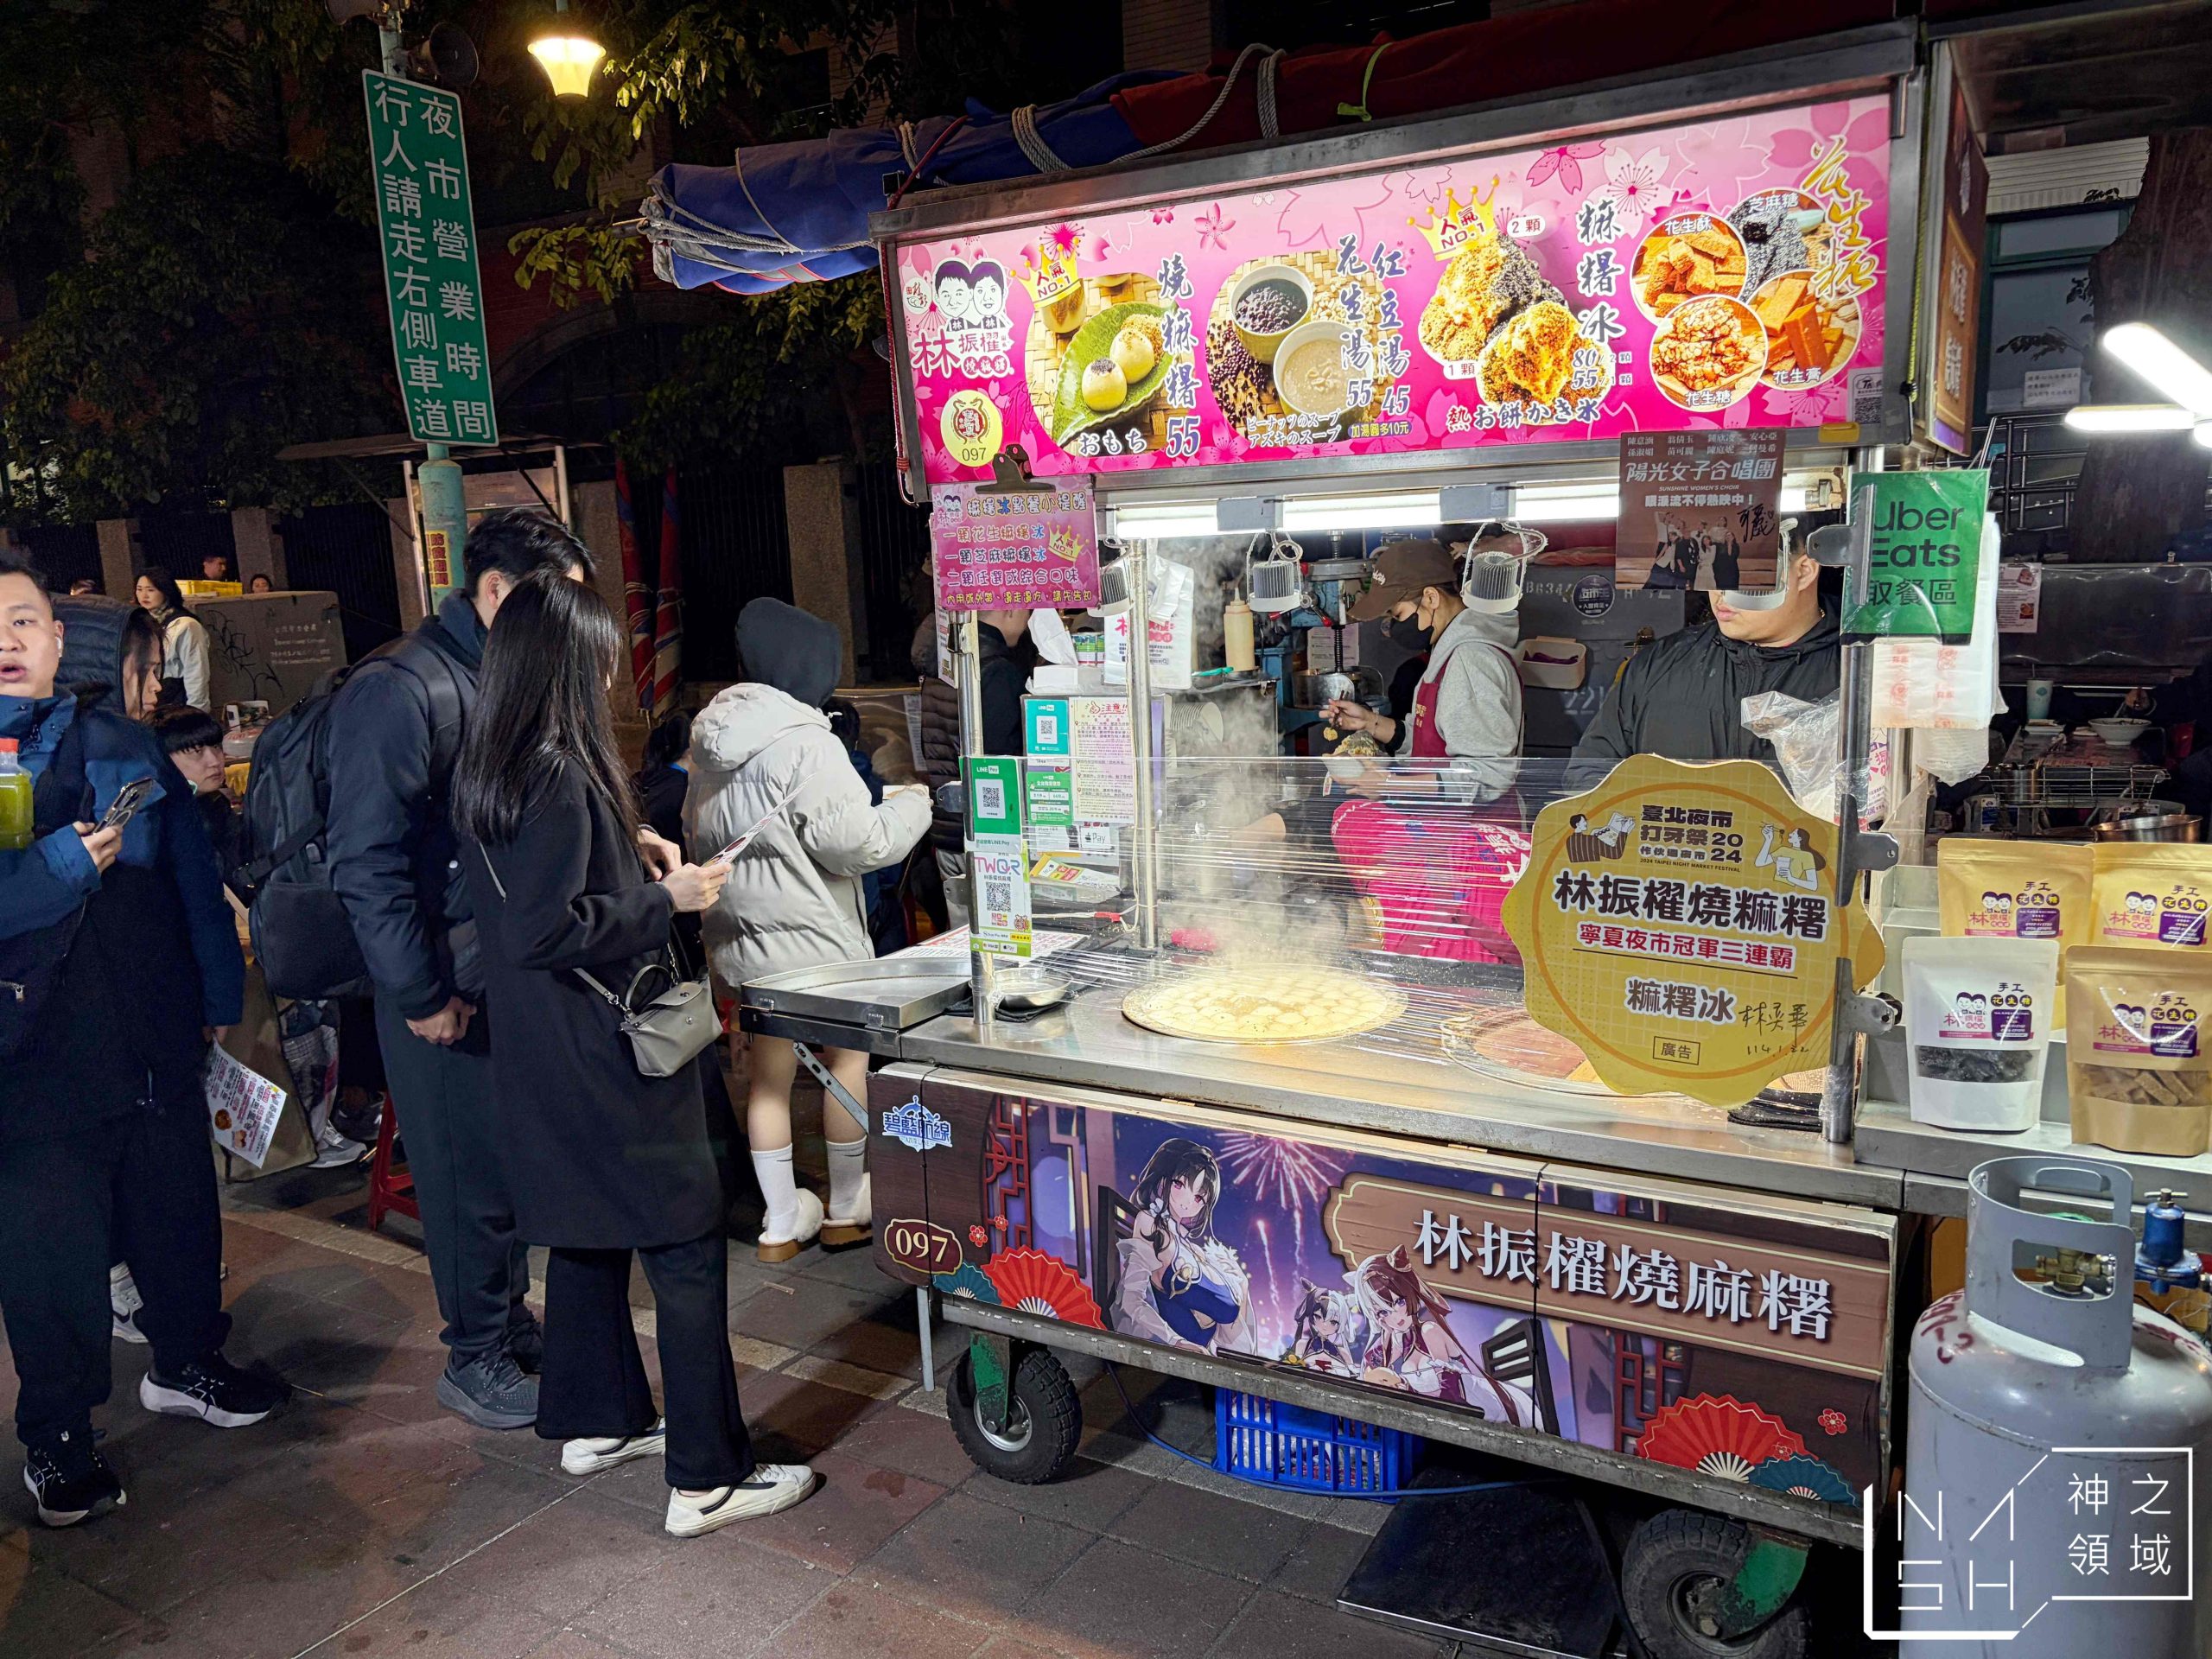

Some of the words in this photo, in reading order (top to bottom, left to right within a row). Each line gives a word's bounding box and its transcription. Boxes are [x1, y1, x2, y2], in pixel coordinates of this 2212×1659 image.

[1750, 194, 1798, 213] 芝麻糖
[1440, 207, 1478, 234] 人氣
[1664, 217, 1713, 234] 花生酥
[1440, 224, 1485, 249] NO.1
[373, 81, 451, 437] 行人請走右側車道
[420, 96, 491, 439] 夜市營業時間
[1037, 261, 1065, 287] 人氣
[1038, 276, 1071, 297] NO.1
[1338, 235, 1371, 369] 花生湯
[1371, 245, 1409, 376] 紅豆湯
[1573, 349, 1599, 366] 80
[1572, 370, 1598, 388] 55
[1774, 369, 1821, 385] 花生膏
[1347, 380, 1372, 406] 55
[1382, 387, 1410, 414] 45
[1685, 391, 1731, 406] 花生糖
[1247, 411, 1338, 431] ピーナッツのスープ
[1081, 429, 1147, 456] おもち
[1167, 416, 1200, 456] 55
[1249, 425, 1341, 448] アズキのスープ
[1750, 432, 1777, 442] 安心亞
[962, 448, 987, 461] 097
[1668, 446, 1694, 455] 苗可麗
[1626, 458, 1777, 482] 陽光女子合唱團
[1053, 543, 1073, 556] NO.1
[1872, 538, 1961, 568] Eats
[947, 568, 1079, 587] 二顆任選或綜合口味
[1869, 579, 1957, 607] 取餐區
[989, 766, 999, 774] Pay
[1642, 804, 1732, 828] 臺北夜市
[1641, 824, 1708, 846] 打牙祭
[1712, 832, 1743, 847] 20
[1711, 849, 1742, 863] 24
[2024, 881, 2051, 891] 手工
[2171, 885, 2200, 896] 手工
[1580, 924, 1794, 969] 寧夏夜市冠軍三連霸
[1998, 982, 2024, 992] 手工
[2161, 995, 2188, 1007] 手工
[1660, 1042, 1692, 1059] 廣告
[884, 1113, 950, 1141] 碧藍航線
[896, 1227, 948, 1264] 097
[1414, 1210, 1833, 1340] 林振櫂燒麻糬
